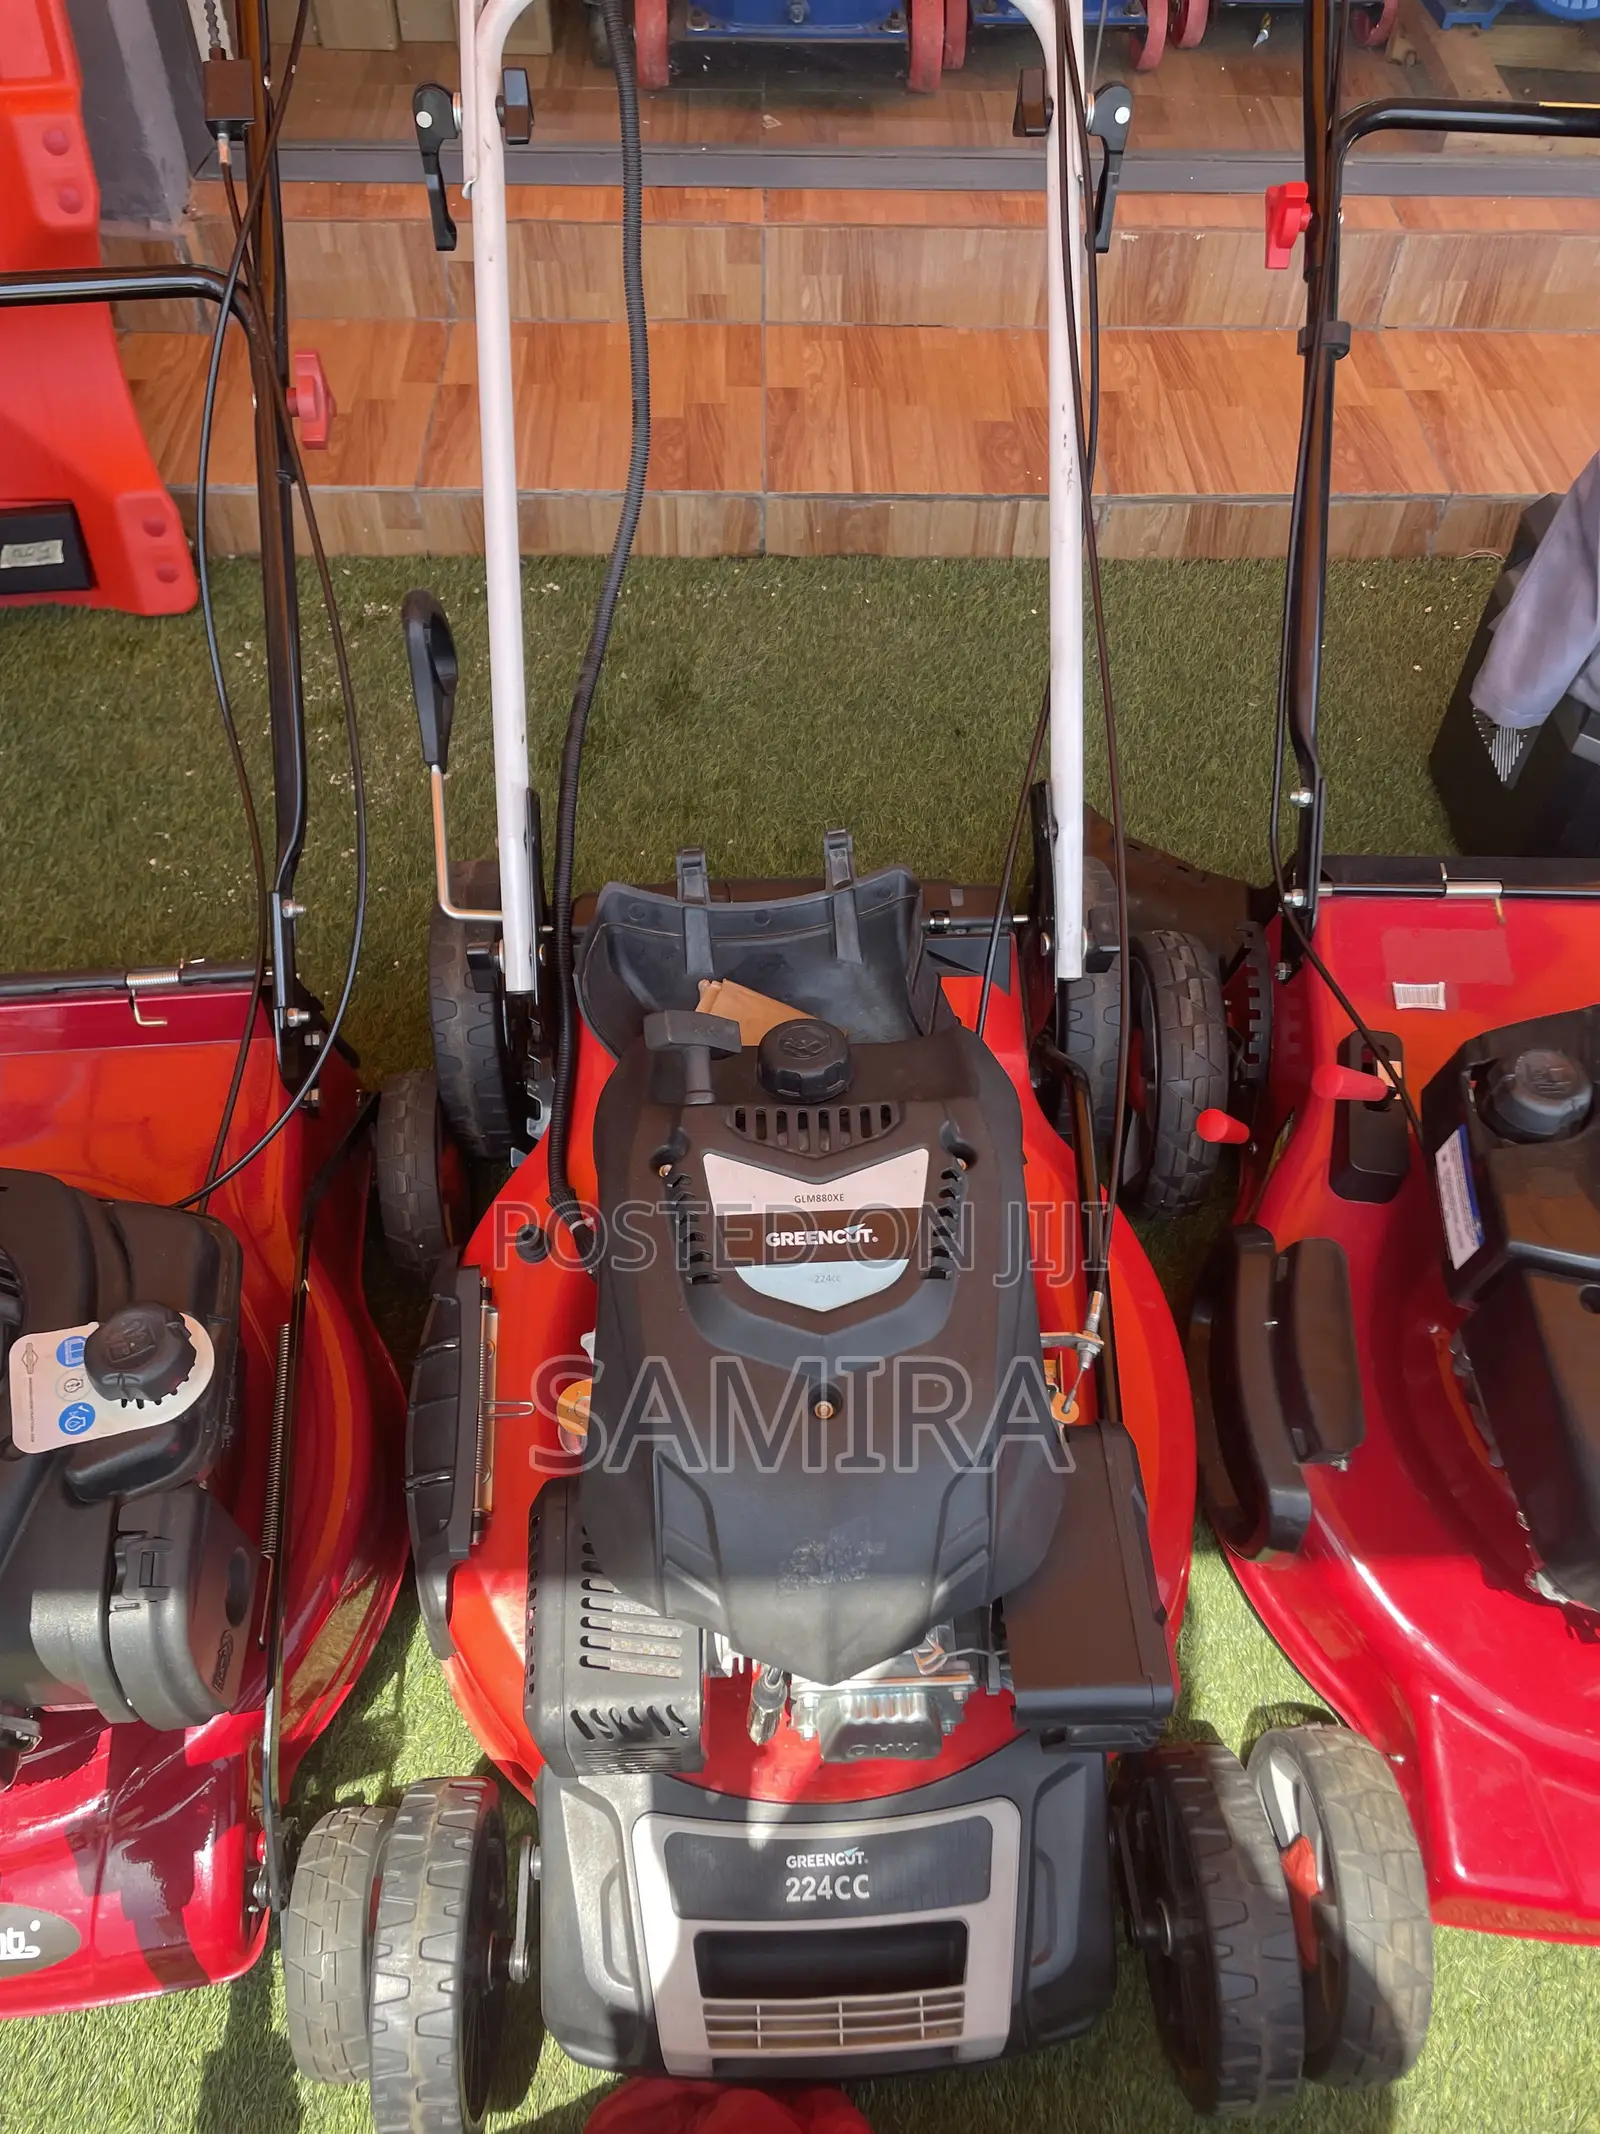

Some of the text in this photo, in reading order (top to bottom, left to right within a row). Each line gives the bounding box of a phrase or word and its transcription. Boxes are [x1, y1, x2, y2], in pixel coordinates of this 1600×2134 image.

[794, 1193, 844, 1204] GLM880XE
[766, 1223, 876, 1248] GREENCUT
[814, 1273, 841, 1284] 224cc
[786, 1847, 867, 1869] GREENCUT
[785, 1874, 870, 1902] 224CC
